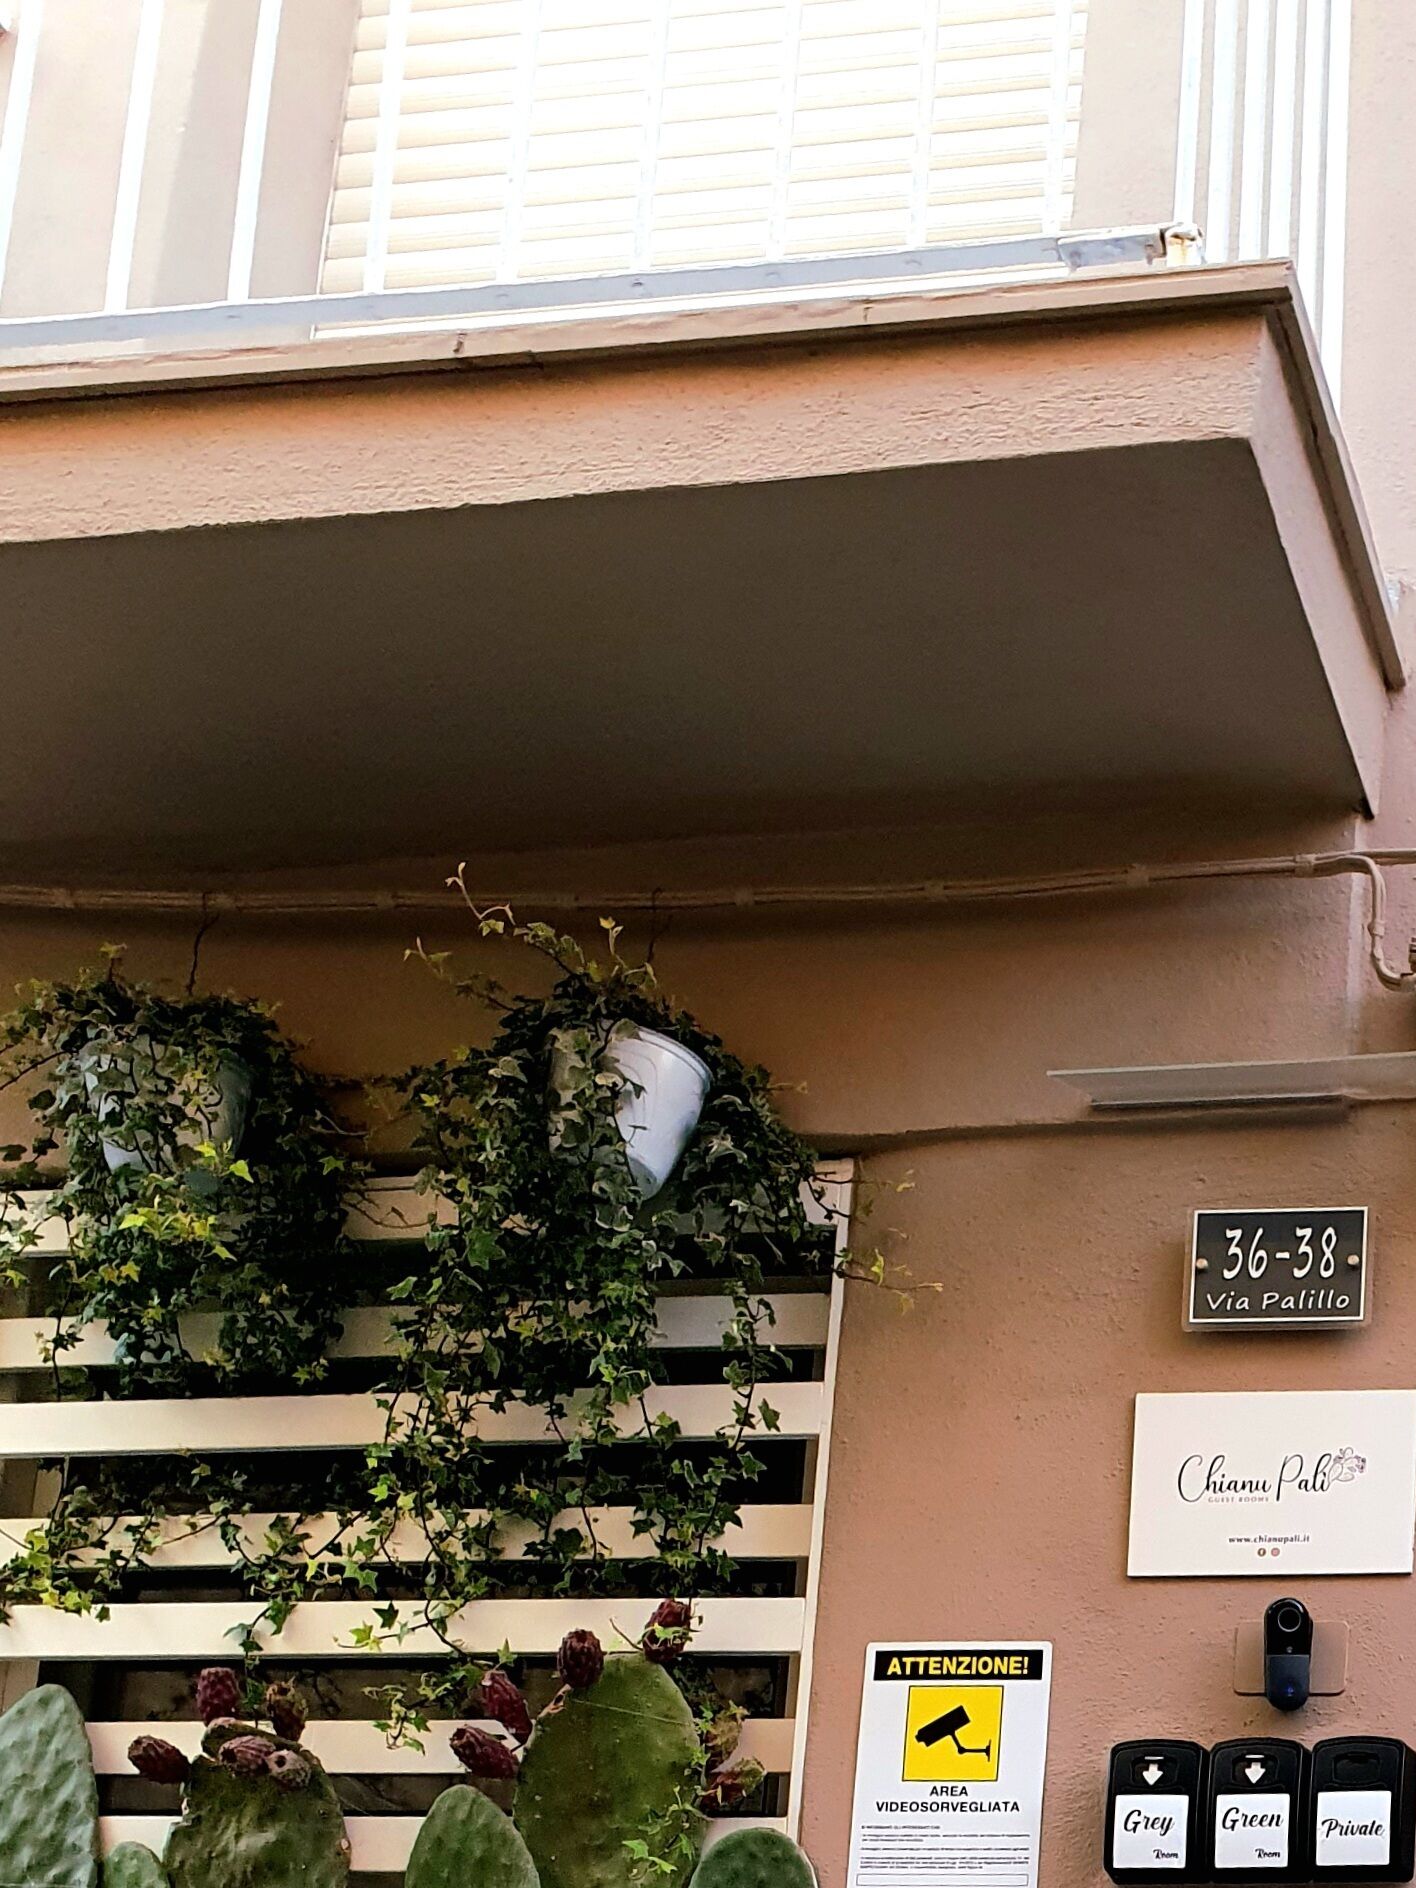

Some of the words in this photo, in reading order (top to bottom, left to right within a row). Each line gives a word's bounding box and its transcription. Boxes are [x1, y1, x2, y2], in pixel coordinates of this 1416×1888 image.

[1222, 1226, 1338, 1279] 36-38
[1206, 1290, 1250, 1310] Via
[1261, 1288, 1350, 1310] Palillo
[1177, 1454, 1272, 1503] Chianu
[1228, 1534, 1310, 1544] www.chianupali.it
[886, 1656, 1029, 1675] ATTENZIONE!
[929, 1785, 968, 1797] AREA
[876, 1800, 1020, 1813] VIDEOSORVEGLIATA
[1123, 1809, 1176, 1836] Grey
[1221, 1806, 1284, 1831] Green
[1321, 1817, 1386, 1838] Private
